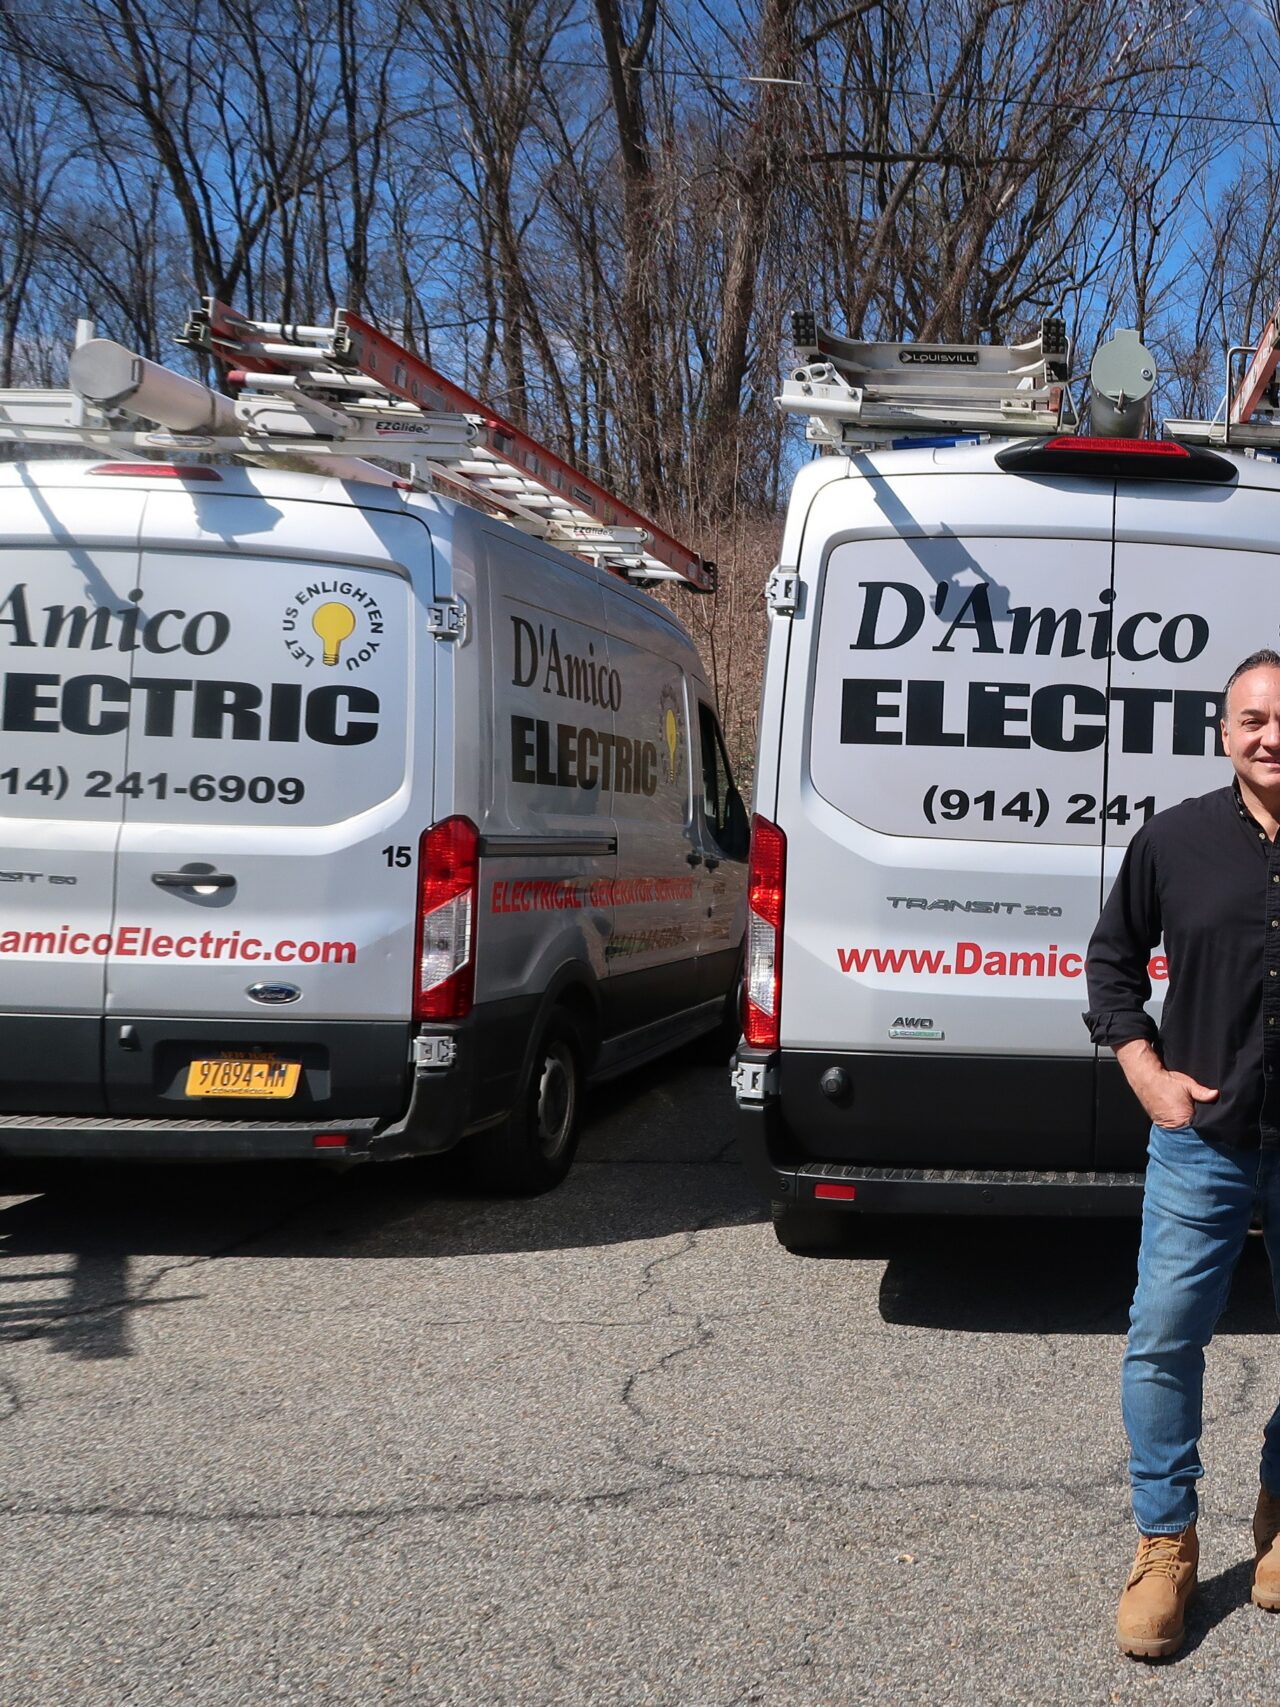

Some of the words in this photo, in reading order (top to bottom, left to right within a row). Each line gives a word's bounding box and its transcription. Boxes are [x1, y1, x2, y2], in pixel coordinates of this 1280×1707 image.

[376, 421, 430, 434] EZGlide2
[282, 607, 299, 631] US
[294, 581, 384, 634] ENLIGHTEN
[850, 581, 1209, 663] D'Amico
[285, 639, 315, 668] LET
[345, 641, 380, 671] YOU
[510, 616, 622, 712] D'Amico
[2, 672, 380, 745] ECTRIC
[511, 715, 658, 796] ELECTRIC
[84, 770, 305, 804] 241-6909
[922, 785, 1050, 828] (914)
[382, 846, 412, 868] 15
[491, 880, 582, 913] ELECTRICAL
[886, 896, 1021, 915] TRANSIT
[1023, 905, 1063, 917] 250
[1, 925, 356, 963] amicoElectric.com
[837, 942, 1168, 980] www.Damice
[891, 1017, 933, 1029] AWD
[199, 1061, 253, 1087] 97894
